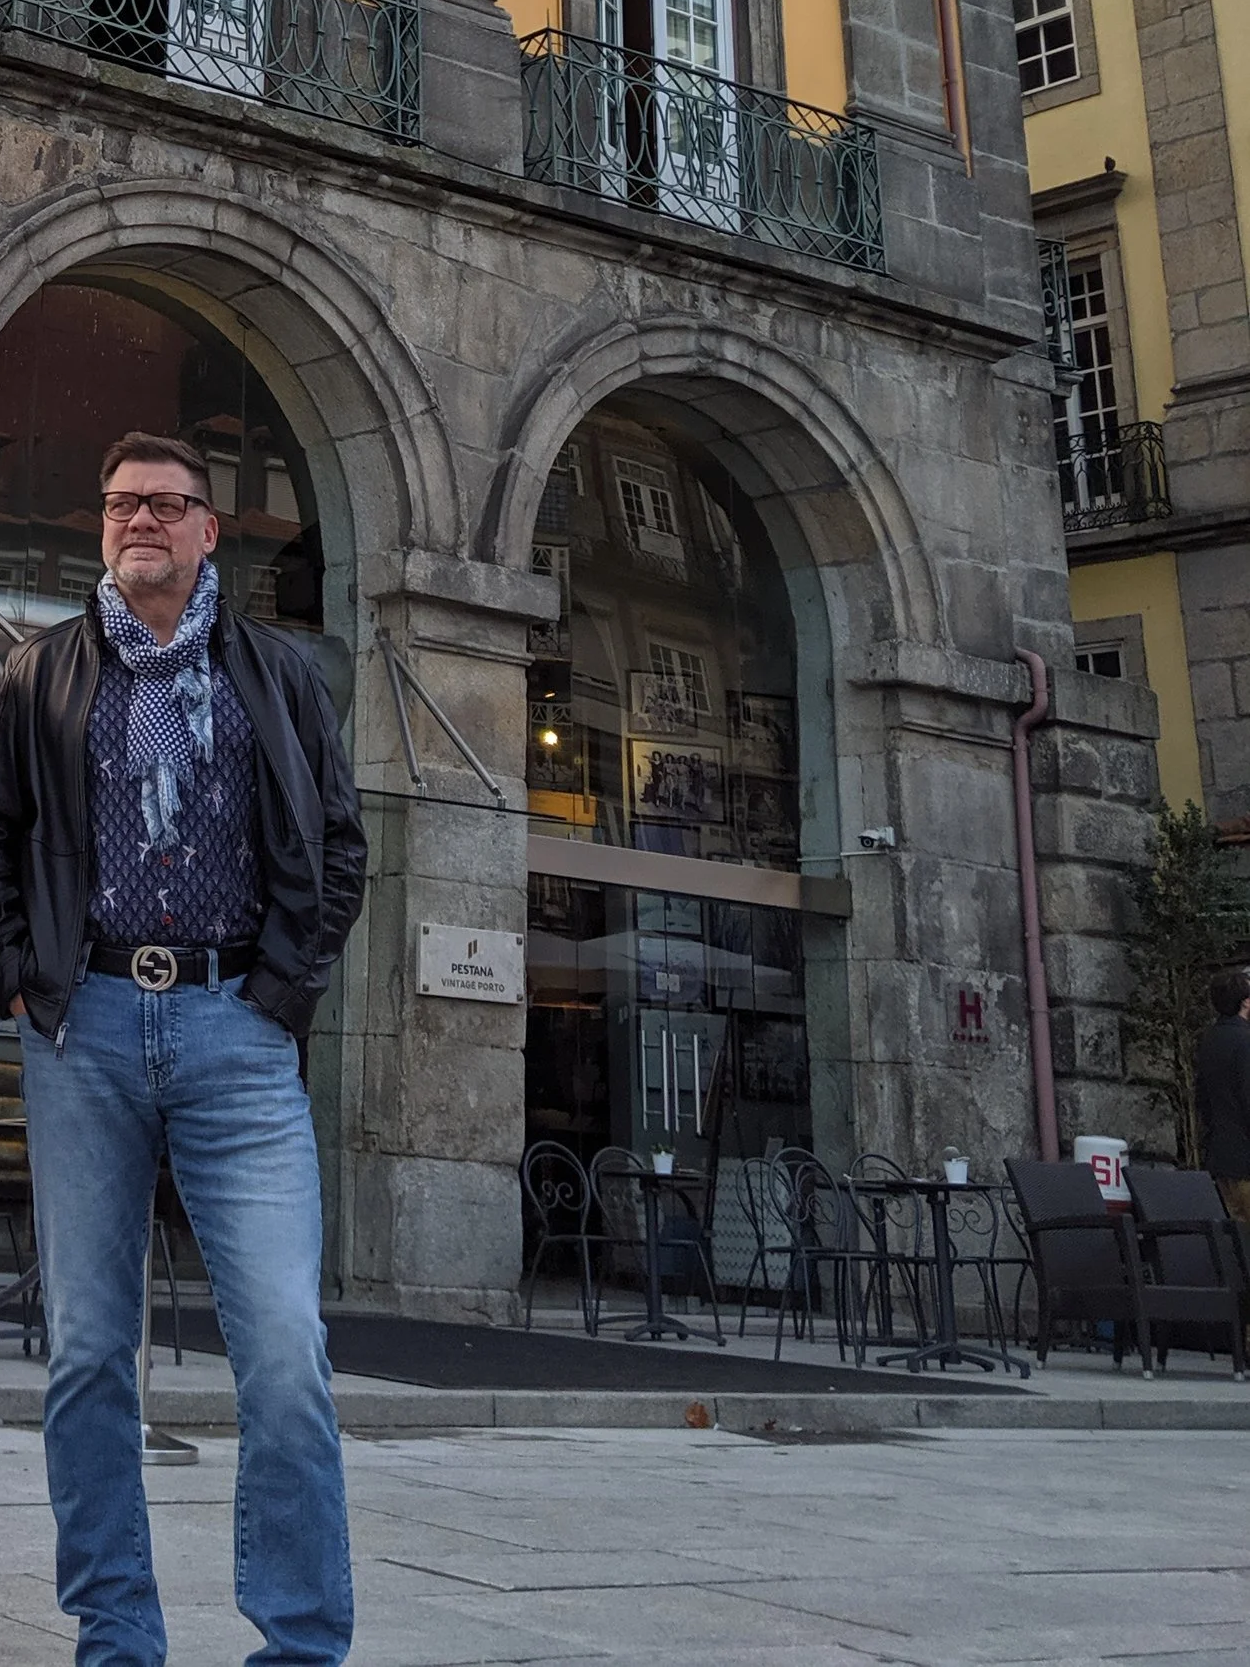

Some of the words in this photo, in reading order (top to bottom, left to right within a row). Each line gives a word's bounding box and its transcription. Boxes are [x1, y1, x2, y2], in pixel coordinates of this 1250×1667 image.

[451, 963, 494, 978] PESTANA
[441, 978, 476, 990] VINTAGE
[478, 982, 505, 993] PORTO
[959, 990, 982, 1030] H
